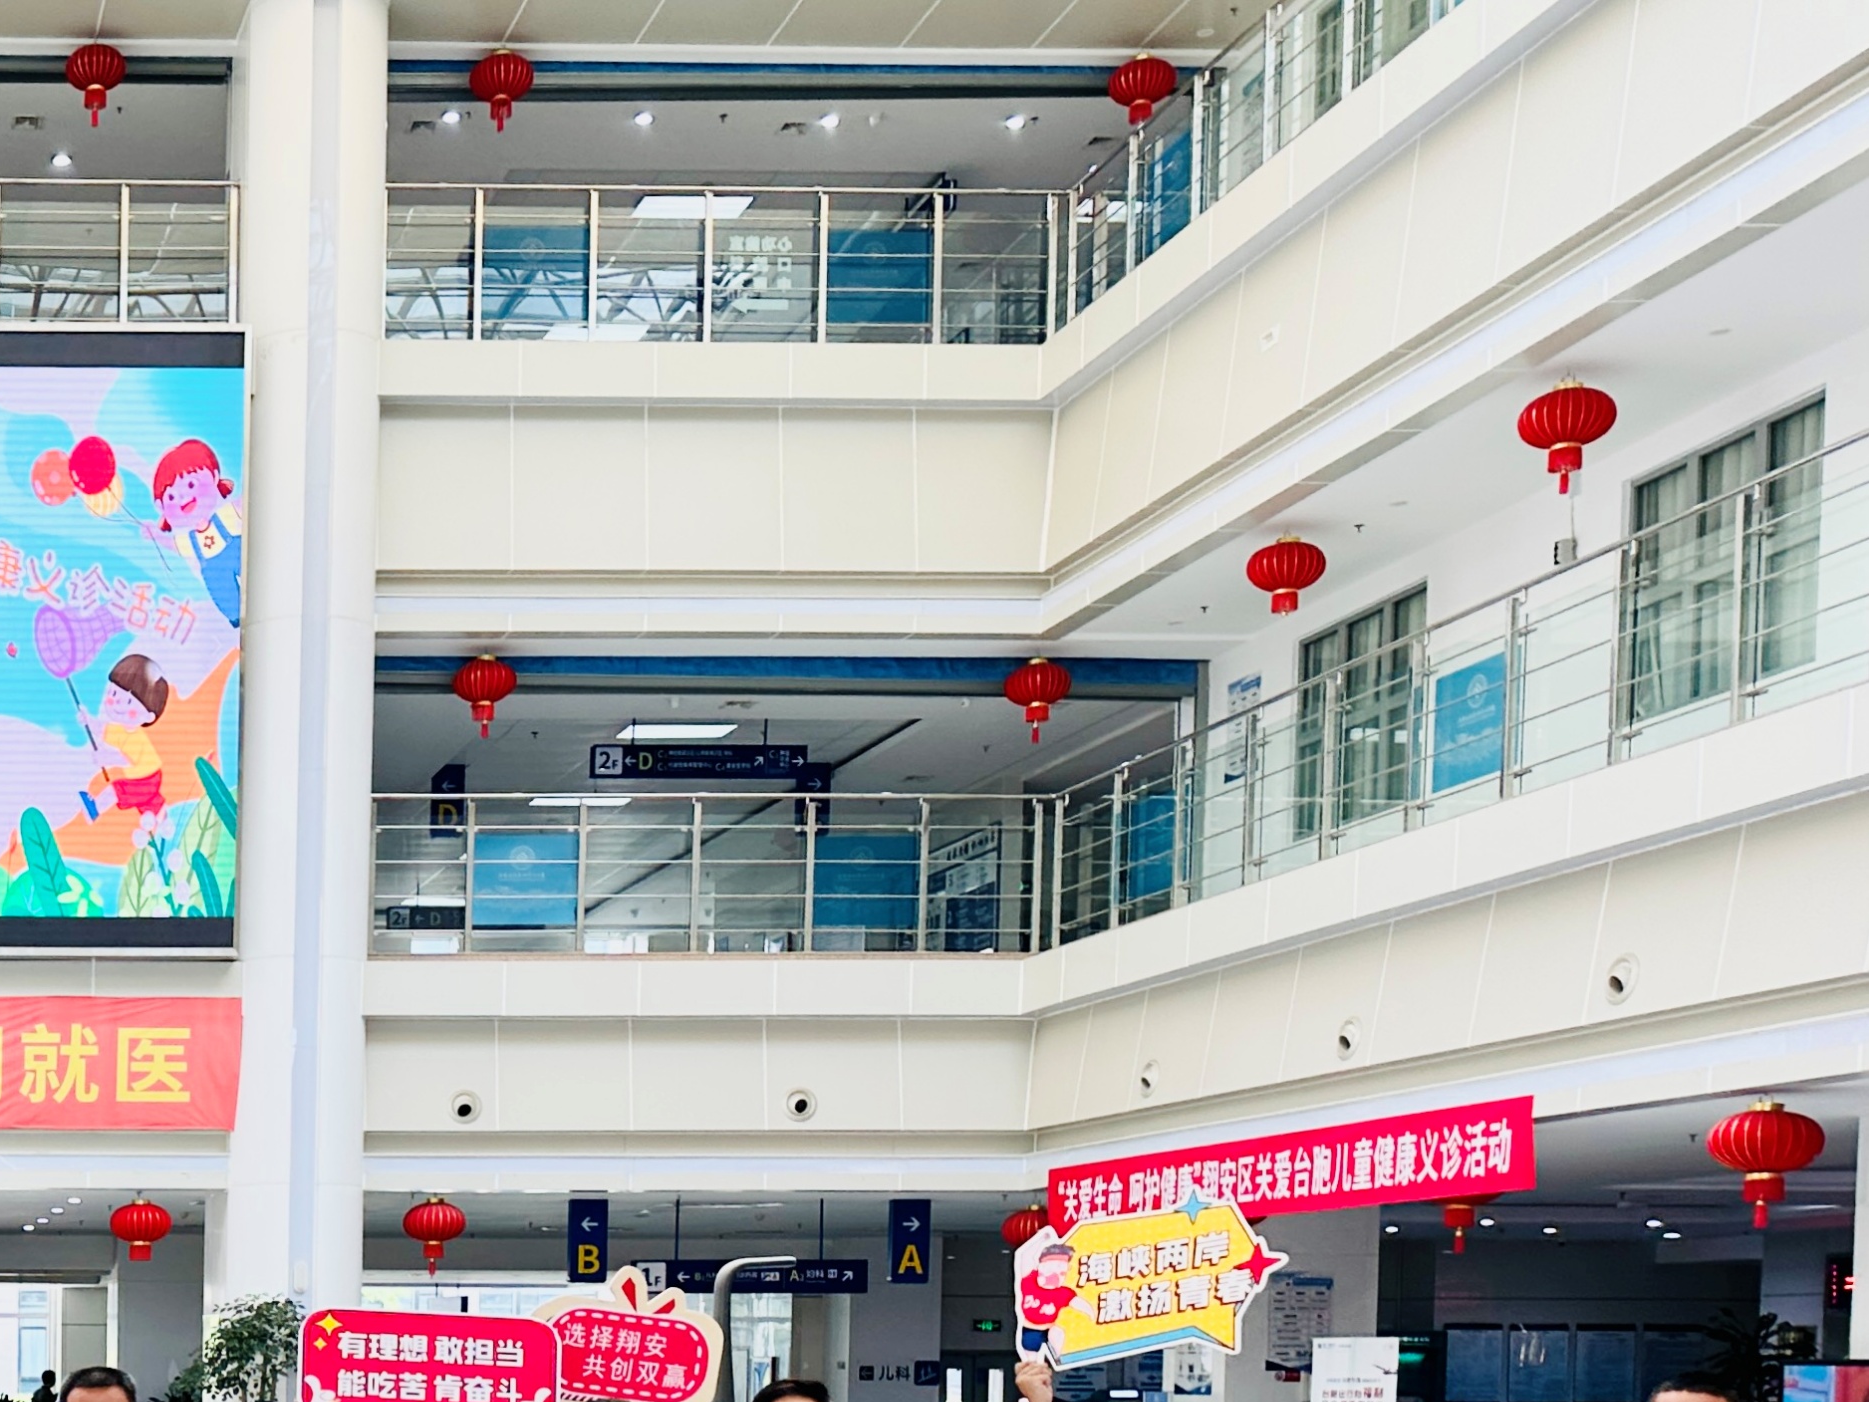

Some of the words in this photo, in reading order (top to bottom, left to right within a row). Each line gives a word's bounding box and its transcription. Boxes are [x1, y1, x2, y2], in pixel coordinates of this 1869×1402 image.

[598, 751, 619, 770] 2F
[638, 752, 653, 771] D
[577, 1244, 601, 1275] B
[898, 1244, 924, 1275] A
[1078, 1231, 1231, 1288] 海峡两岸
[1095, 1267, 1256, 1325] 激扬青春
[337, 1331, 429, 1363] 有理想
[433, 1335, 525, 1367] 敢担当
[562, 1321, 668, 1358] 选择翔安
[337, 1370, 427, 1401] 能吃苦
[582, 1354, 689, 1391] 共创双赢
[878, 1364, 911, 1381] 儿科
